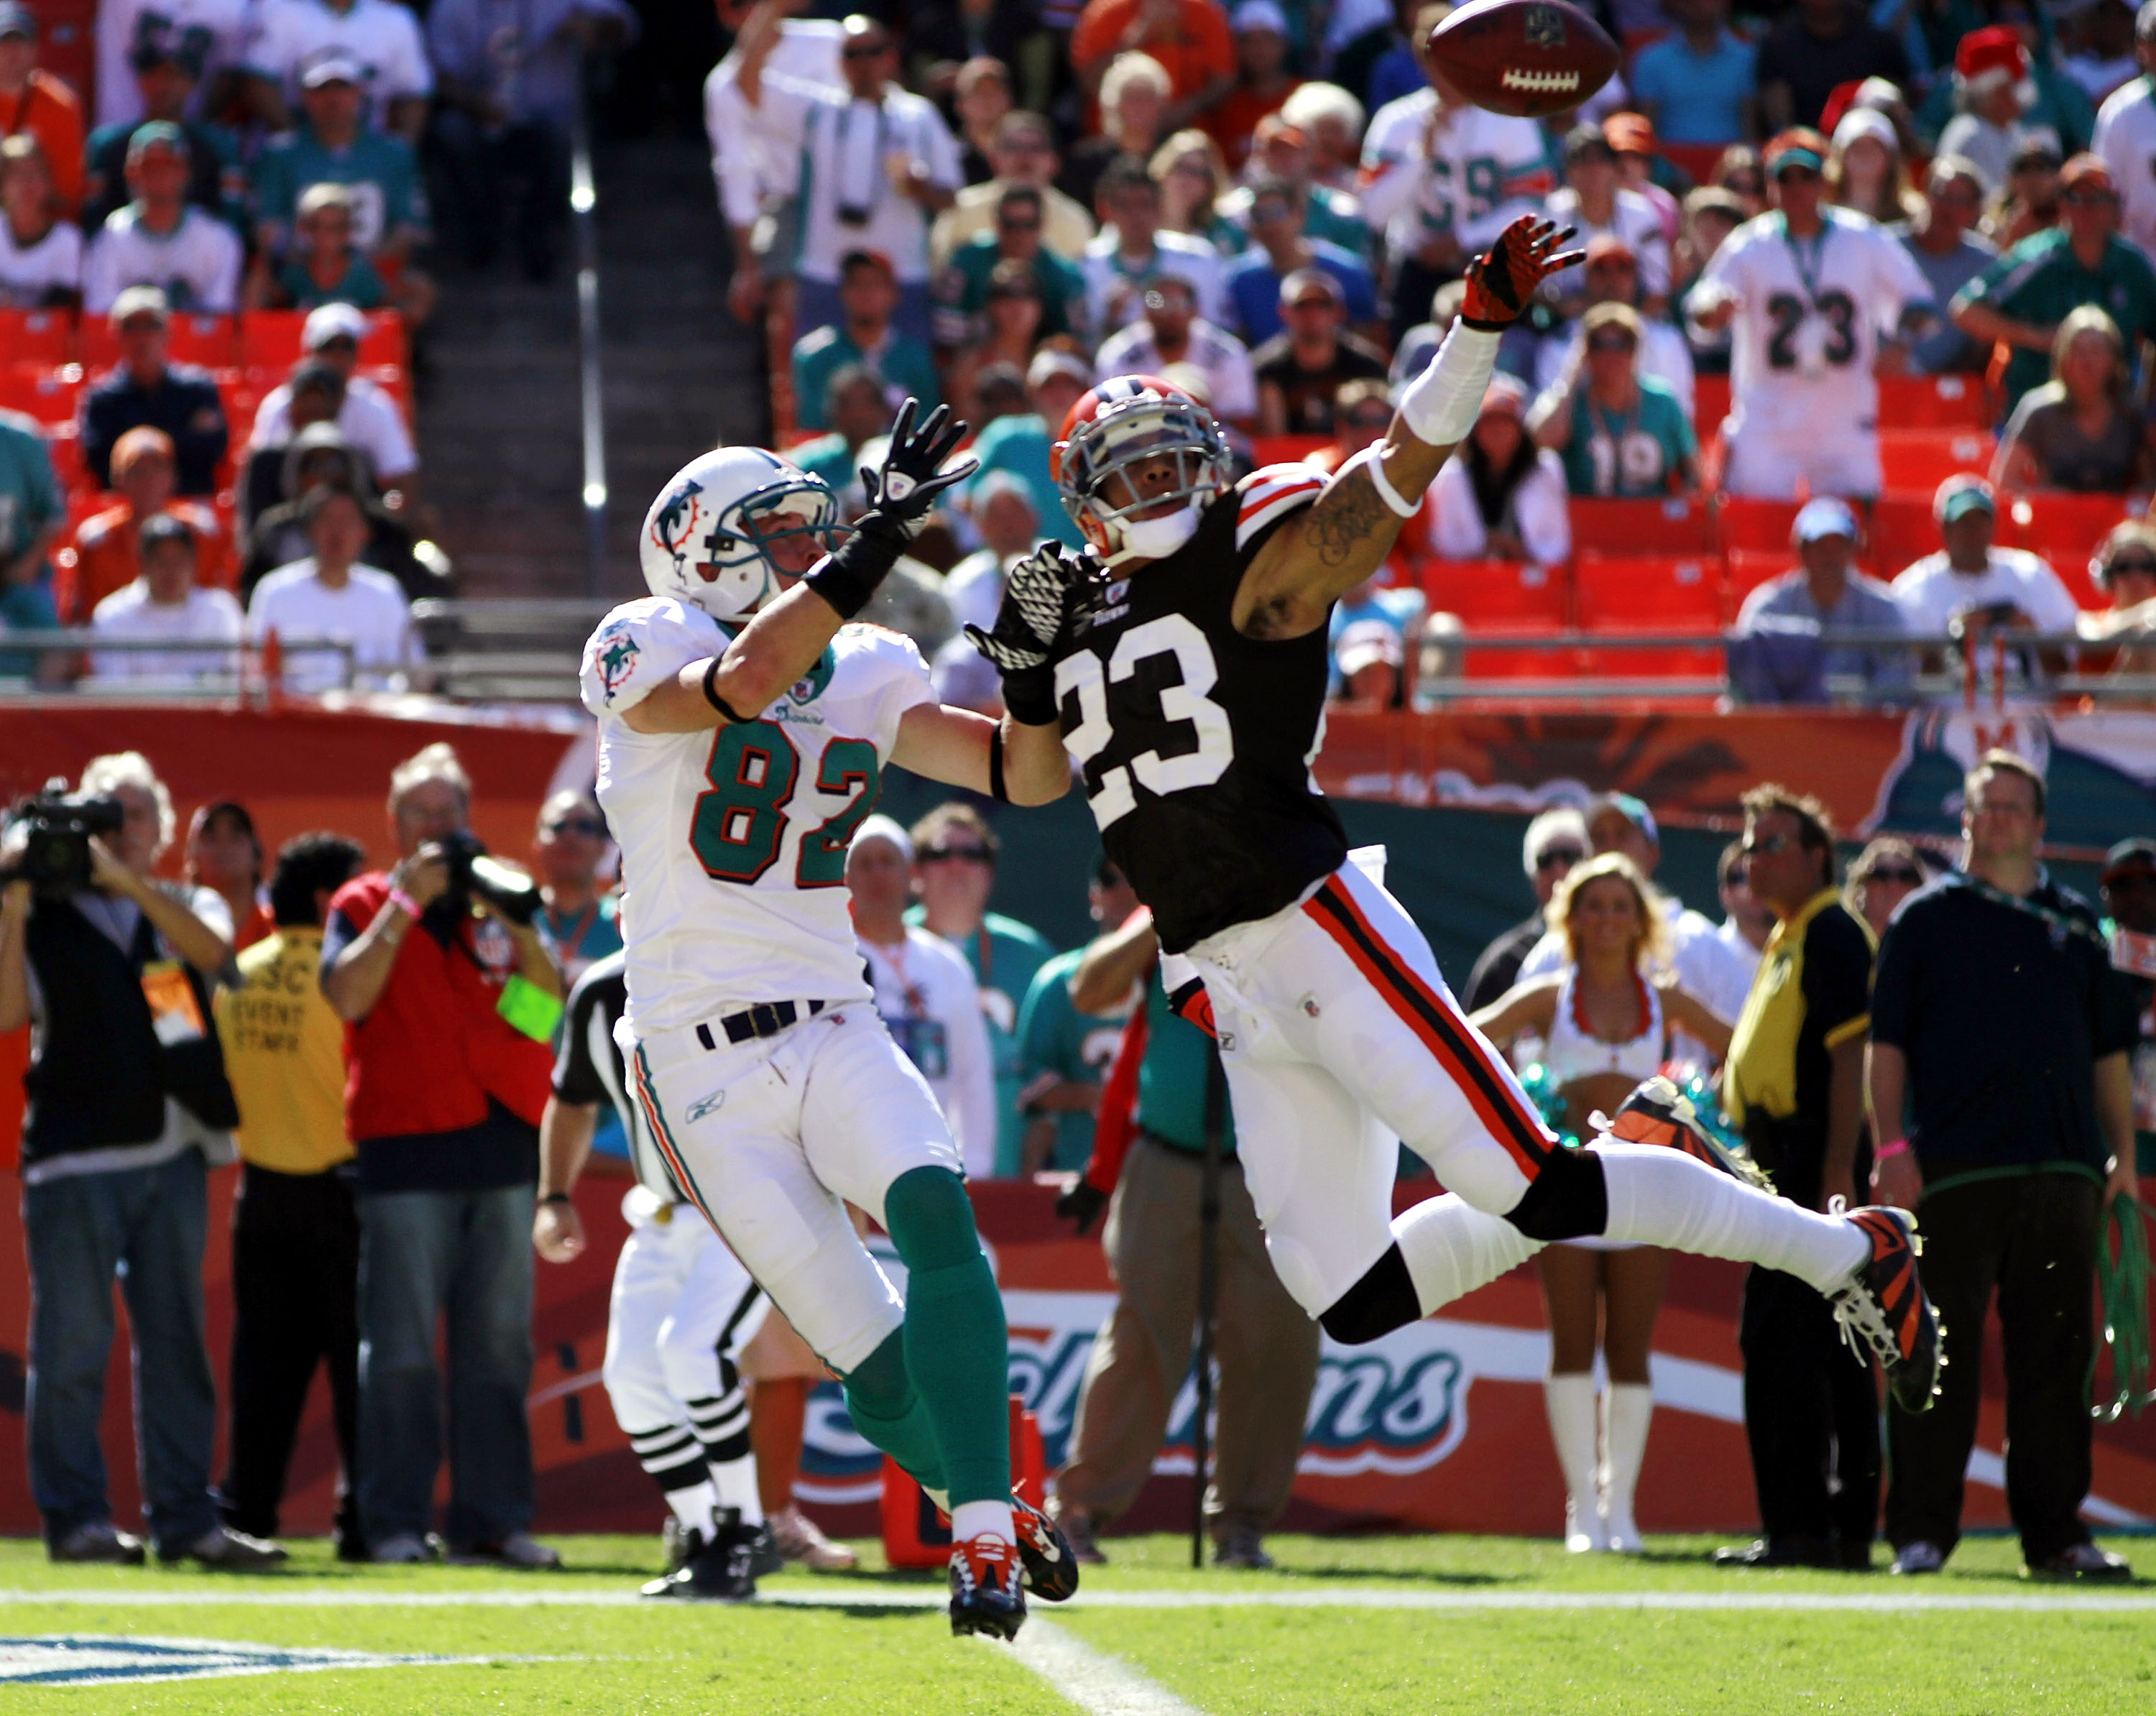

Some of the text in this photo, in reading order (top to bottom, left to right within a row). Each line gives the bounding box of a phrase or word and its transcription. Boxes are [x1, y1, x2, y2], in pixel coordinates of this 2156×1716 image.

[1767, 291, 1856, 369] 23
[689, 718, 883, 891] 82
[1054, 612, 1235, 834] 23
